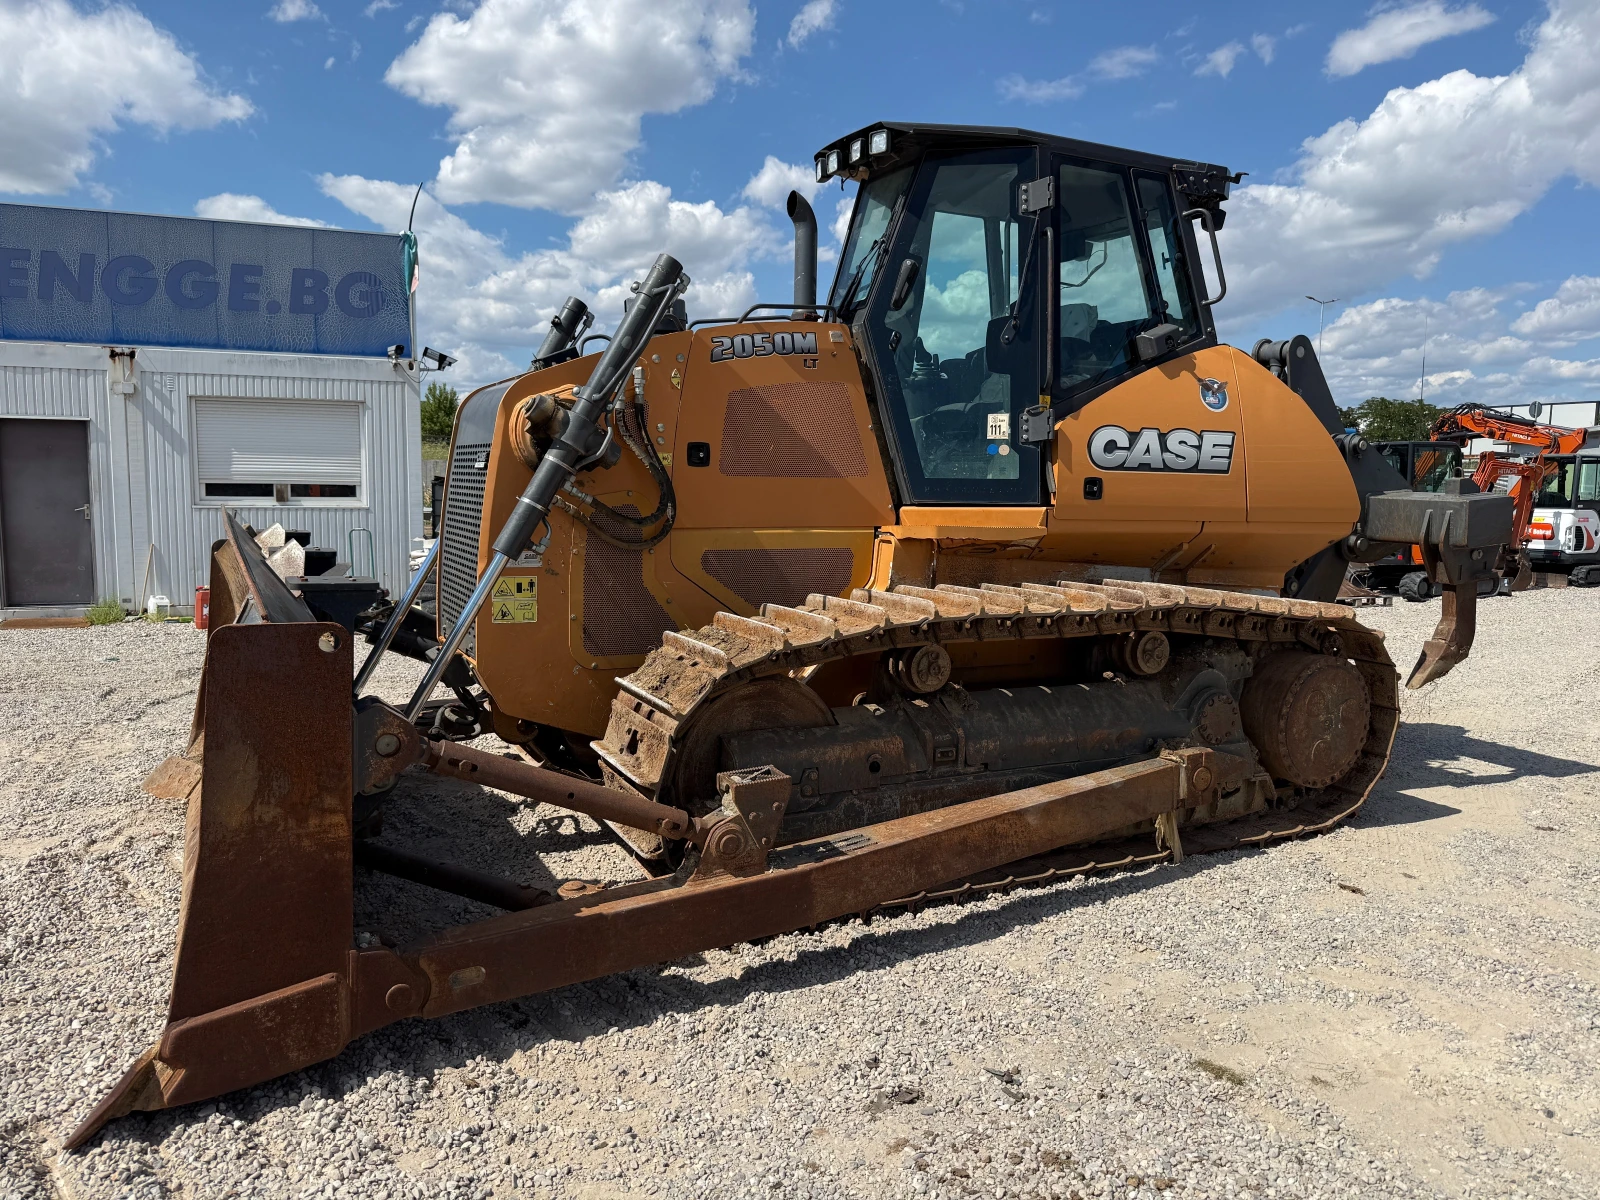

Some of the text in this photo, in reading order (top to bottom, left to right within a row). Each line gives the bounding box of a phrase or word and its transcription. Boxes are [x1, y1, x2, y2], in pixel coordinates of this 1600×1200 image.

[710, 332, 818, 363] 2050M
[803, 358, 819, 369] LT
[990, 424, 1002, 436] 111
[1089, 425, 1236, 473] CASE
